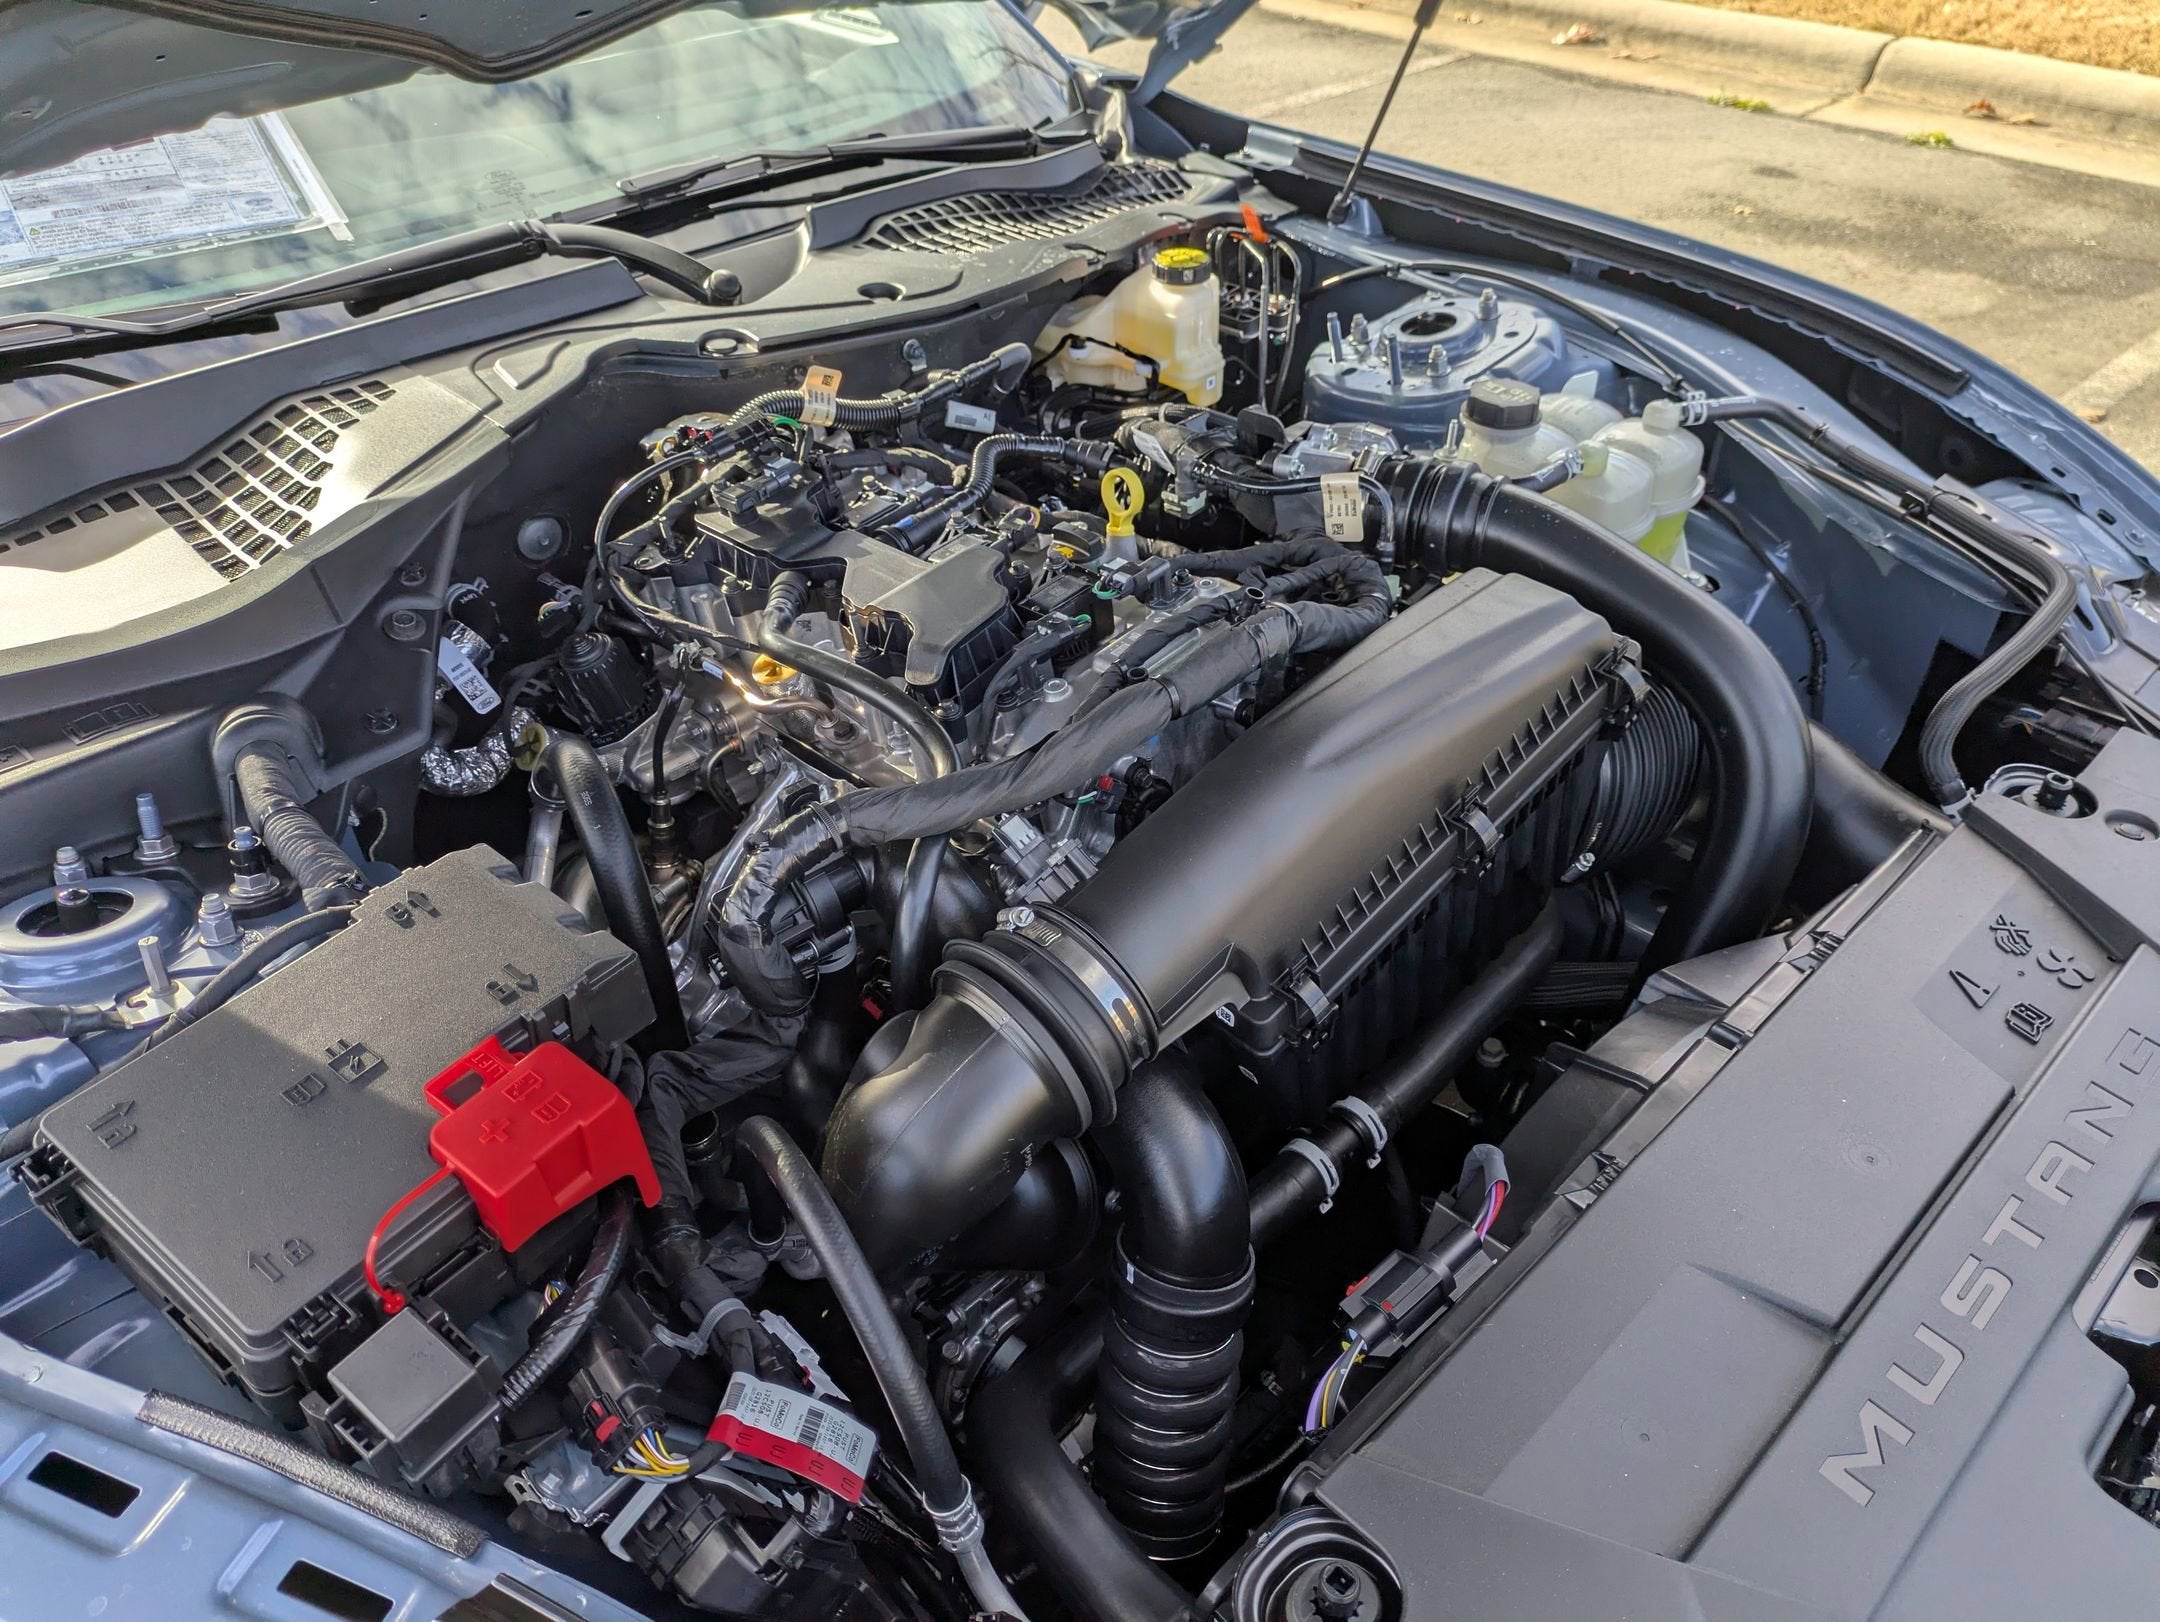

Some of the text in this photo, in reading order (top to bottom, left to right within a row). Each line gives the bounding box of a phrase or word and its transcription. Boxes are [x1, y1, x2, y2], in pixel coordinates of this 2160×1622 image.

[471, 1053, 504, 1078] LIFT
[1818, 1027, 2160, 1508] MUSTANG
[773, 1401, 789, 1429] FoMoCo
[735, 1432, 753, 1448] UJ
[848, 1434, 861, 1463] FoMoCo
[770, 1444, 787, 1460] UJ
[808, 1459, 825, 1477] UJ
[840, 1476, 856, 1495] UJ
